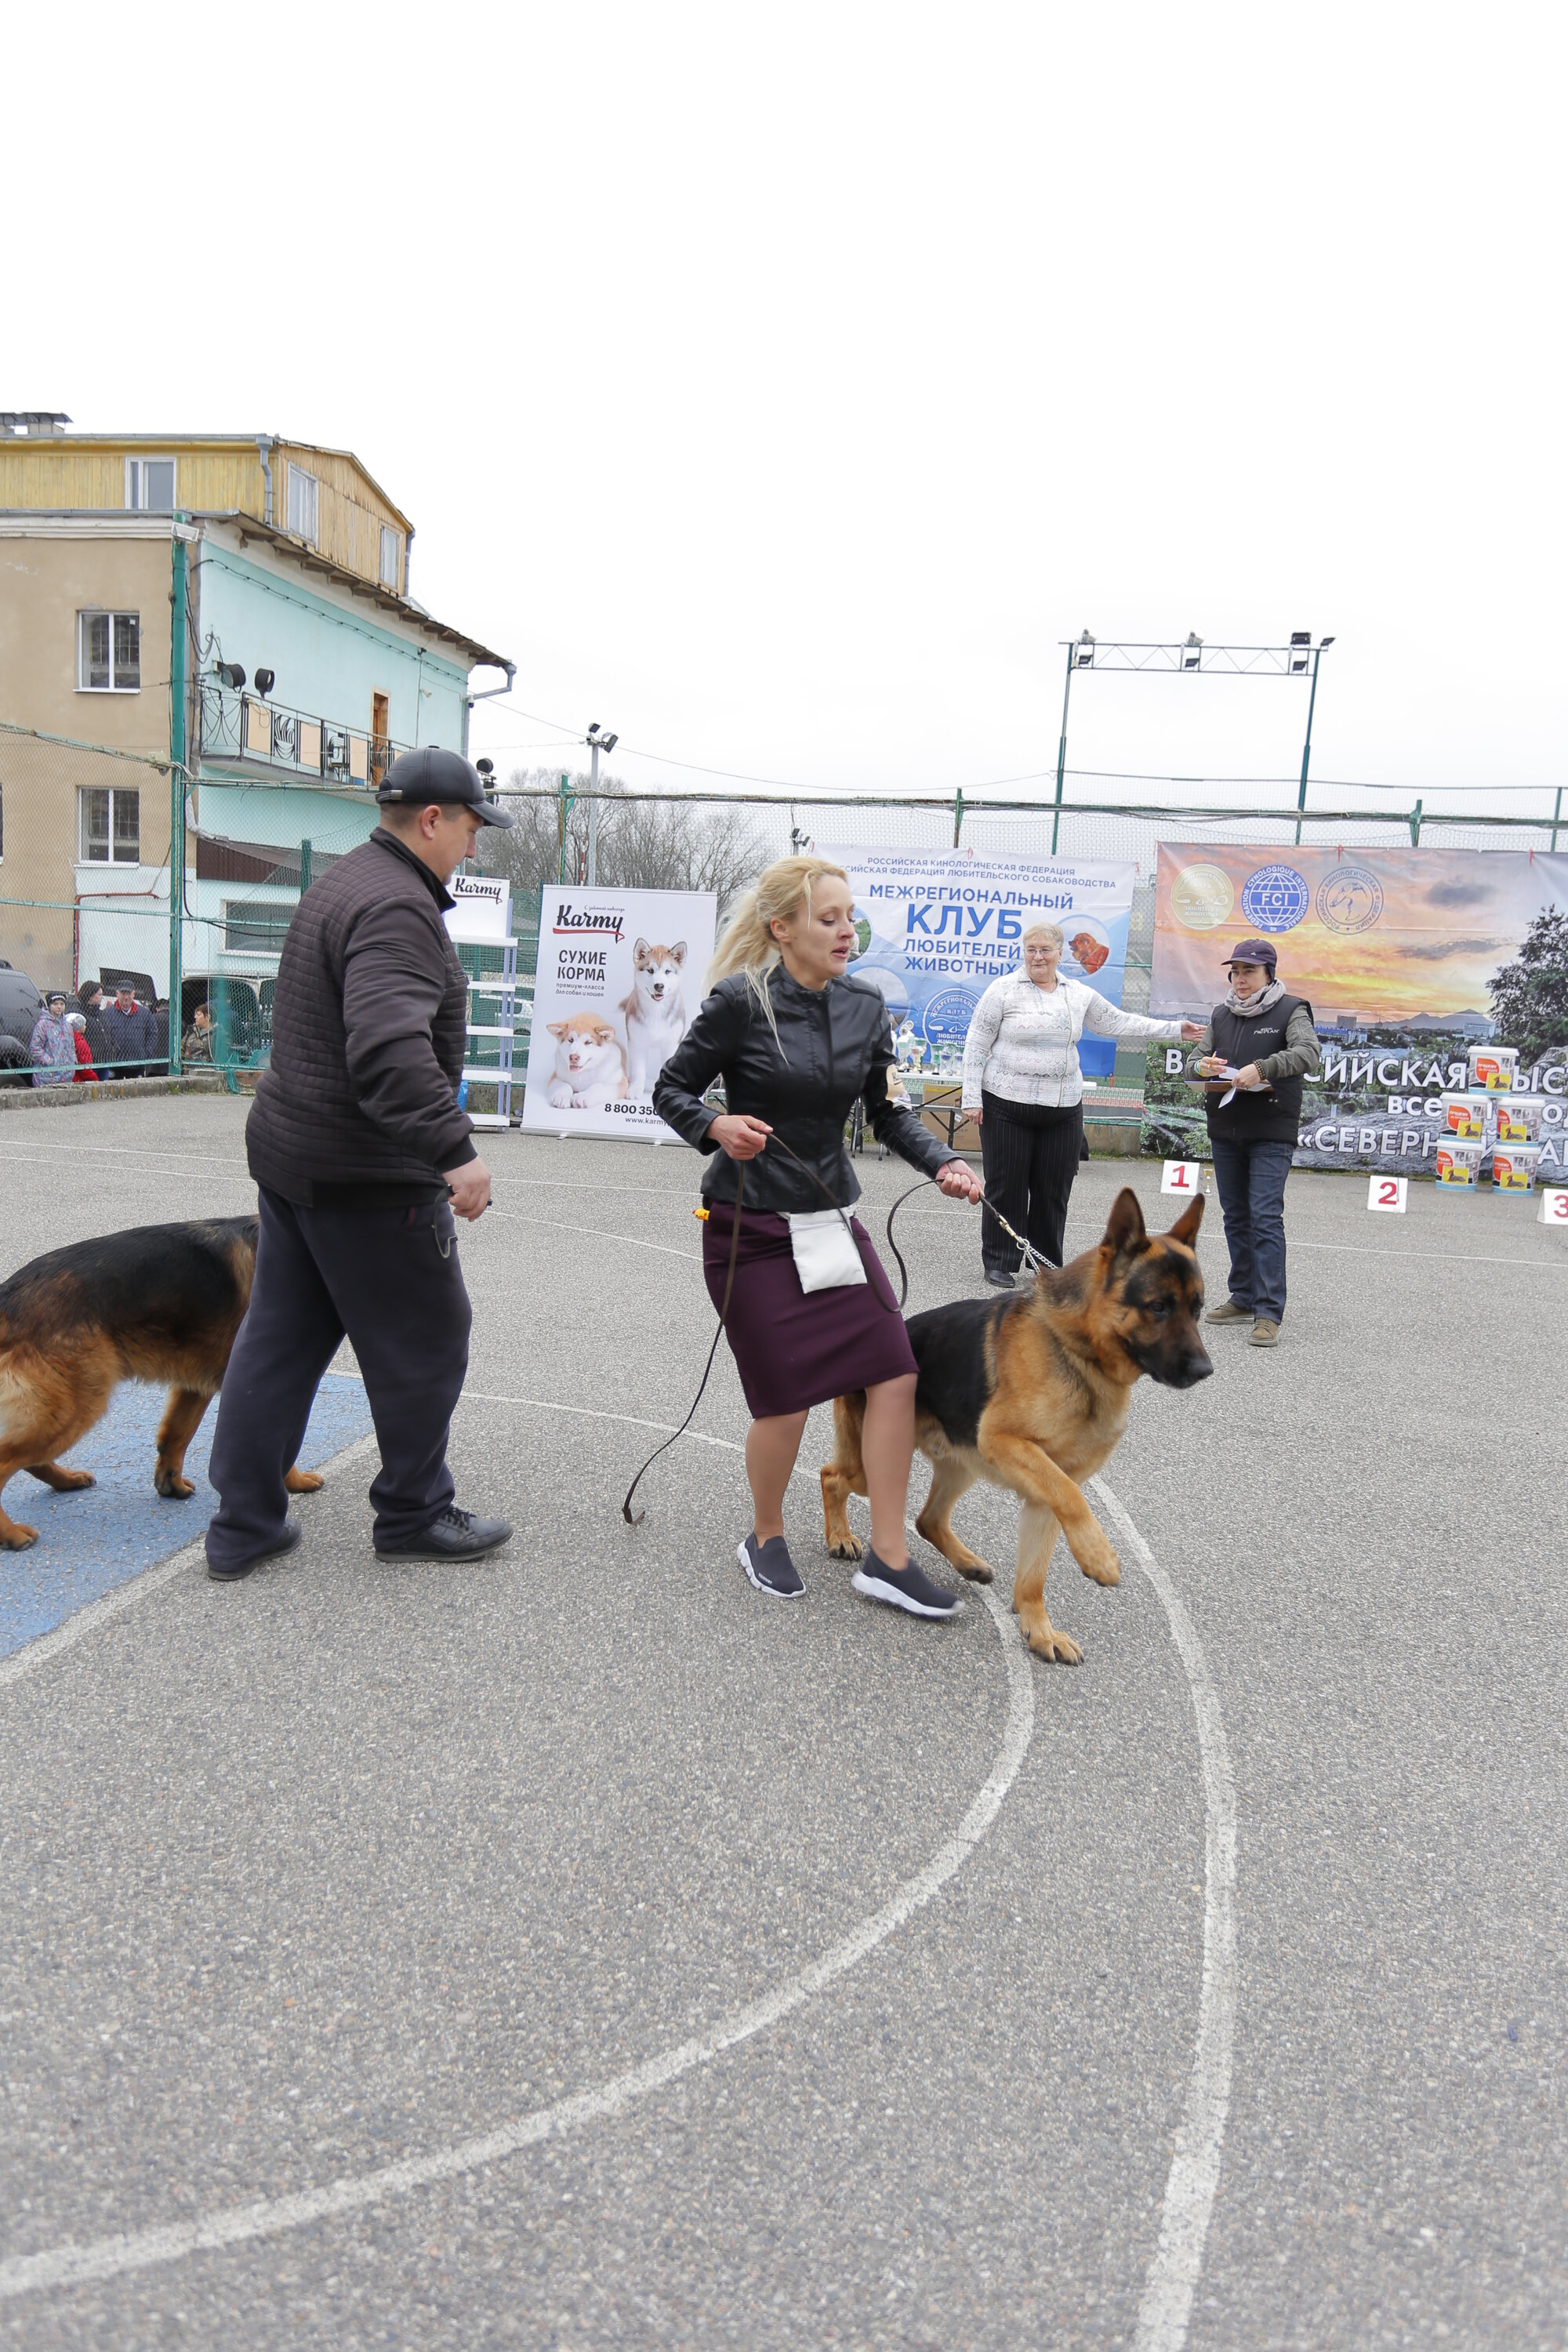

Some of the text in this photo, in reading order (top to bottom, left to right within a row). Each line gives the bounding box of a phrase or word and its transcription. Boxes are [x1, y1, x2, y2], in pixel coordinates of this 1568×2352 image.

[837, 865, 1116, 888] ССИЙСКАЯ ФЕДЕРАЦИЯ ЛЮБИТЕЛЬСКОГО СОБАКОВОДСТВА
[867, 857, 1076, 876] РОССИЙСКАЯ КИНОЛОГИЧЕСКАЯ ФЕДЕРАЦИЯ
[1247, 866, 1295, 887] CYNOLOGIQUE
[455, 877, 501, 905] Karmy
[869, 884, 1073, 910] МЕЖРЕГИОНАЛЬНЫЙ
[1261, 893, 1289, 906] FCI
[1284, 875, 1308, 930] INTERNATIONALE
[1243, 889, 1263, 929] FEDERATION
[556, 904, 624, 944] Karmy
[906, 903, 1022, 940] КЛУБ
[558, 949, 608, 965] СУХИЕ
[903, 938, 1021, 960] ЛЮБИТЕЛЕЙ
[557, 966, 605, 982] КОРМА
[904, 956, 1018, 976] ЖИВОТНЫХ
[604, 1103, 612, 1112] 8
[613, 1104, 637, 1114] 800
[625, 1117, 670, 1127] www.karmy
[1537, 1137, 1568, 1167] А
[1171, 1165, 1190, 1188] 1
[1377, 1181, 1398, 1205] 2
[1554, 1194, 1568, 1218] 3
